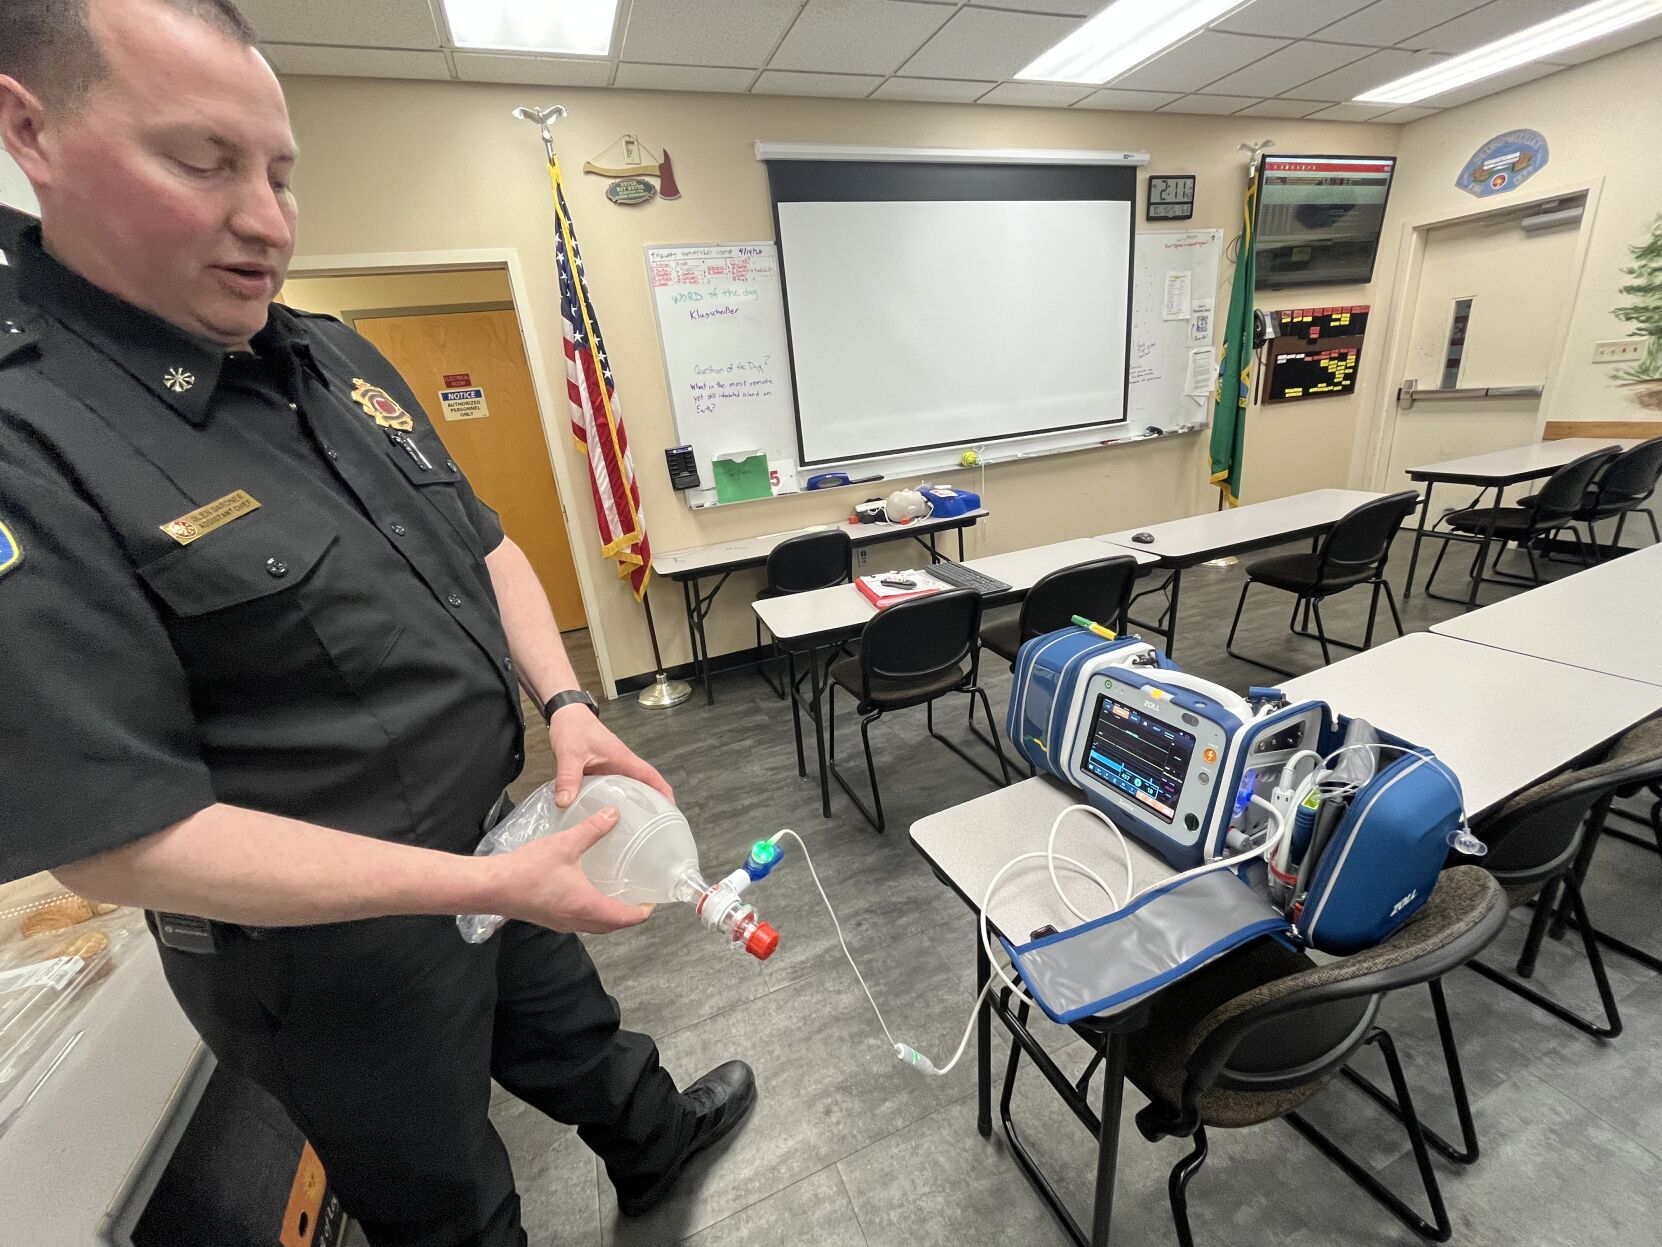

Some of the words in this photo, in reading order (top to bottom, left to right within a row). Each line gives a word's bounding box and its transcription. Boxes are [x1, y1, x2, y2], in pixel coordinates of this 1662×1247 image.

[1160, 180, 1187, 200] 2:11
[672, 291, 703, 304] WORD
[708, 286, 718, 298] of
[694, 364, 724, 375] Question
[727, 363, 734, 373] of
[690, 382, 706, 391] What
[716, 381, 726, 389] the
[729, 380, 746, 388] most
[749, 378, 773, 387] remote
[448, 391, 476, 400] NOTICE
[693, 394, 703, 404] yet
[742, 390, 760, 398] island
[447, 400, 481, 408] AUTHORIZED
[450, 405, 481, 413] PERSONNEL
[1143, 699, 1160, 712] ZOLL
[1390, 888, 1417, 917] ZOLL
